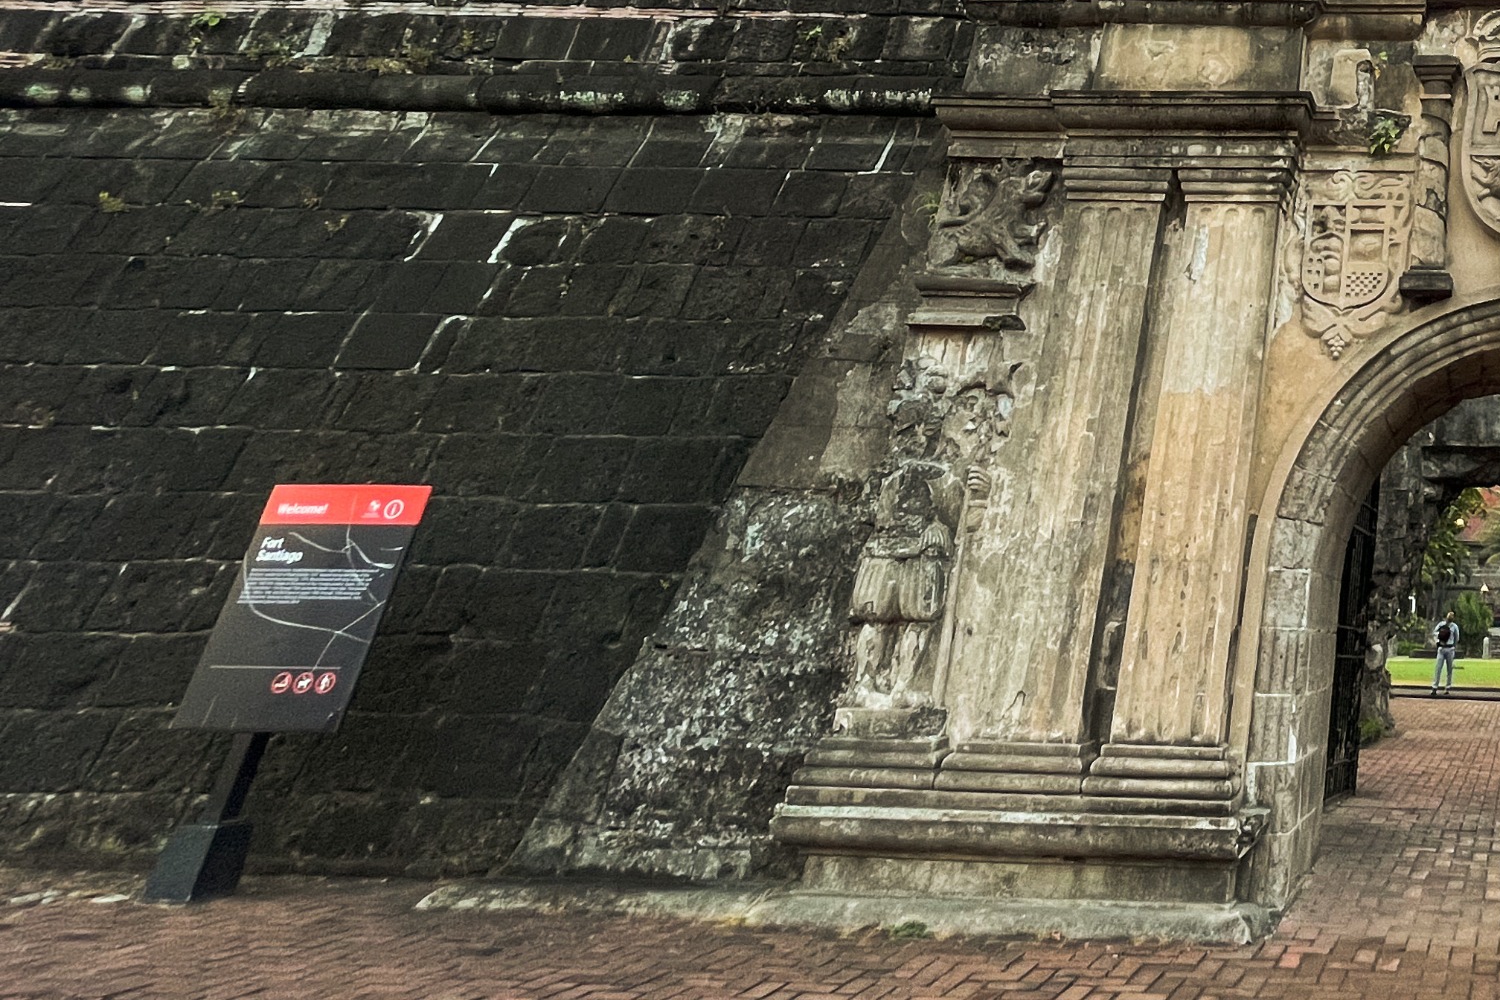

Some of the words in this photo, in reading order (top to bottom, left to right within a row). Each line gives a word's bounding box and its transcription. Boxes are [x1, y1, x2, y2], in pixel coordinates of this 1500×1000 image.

[277, 503, 329, 515] Welcome!
[260, 536, 285, 549] Fort
[256, 549, 304, 564] Santiago
